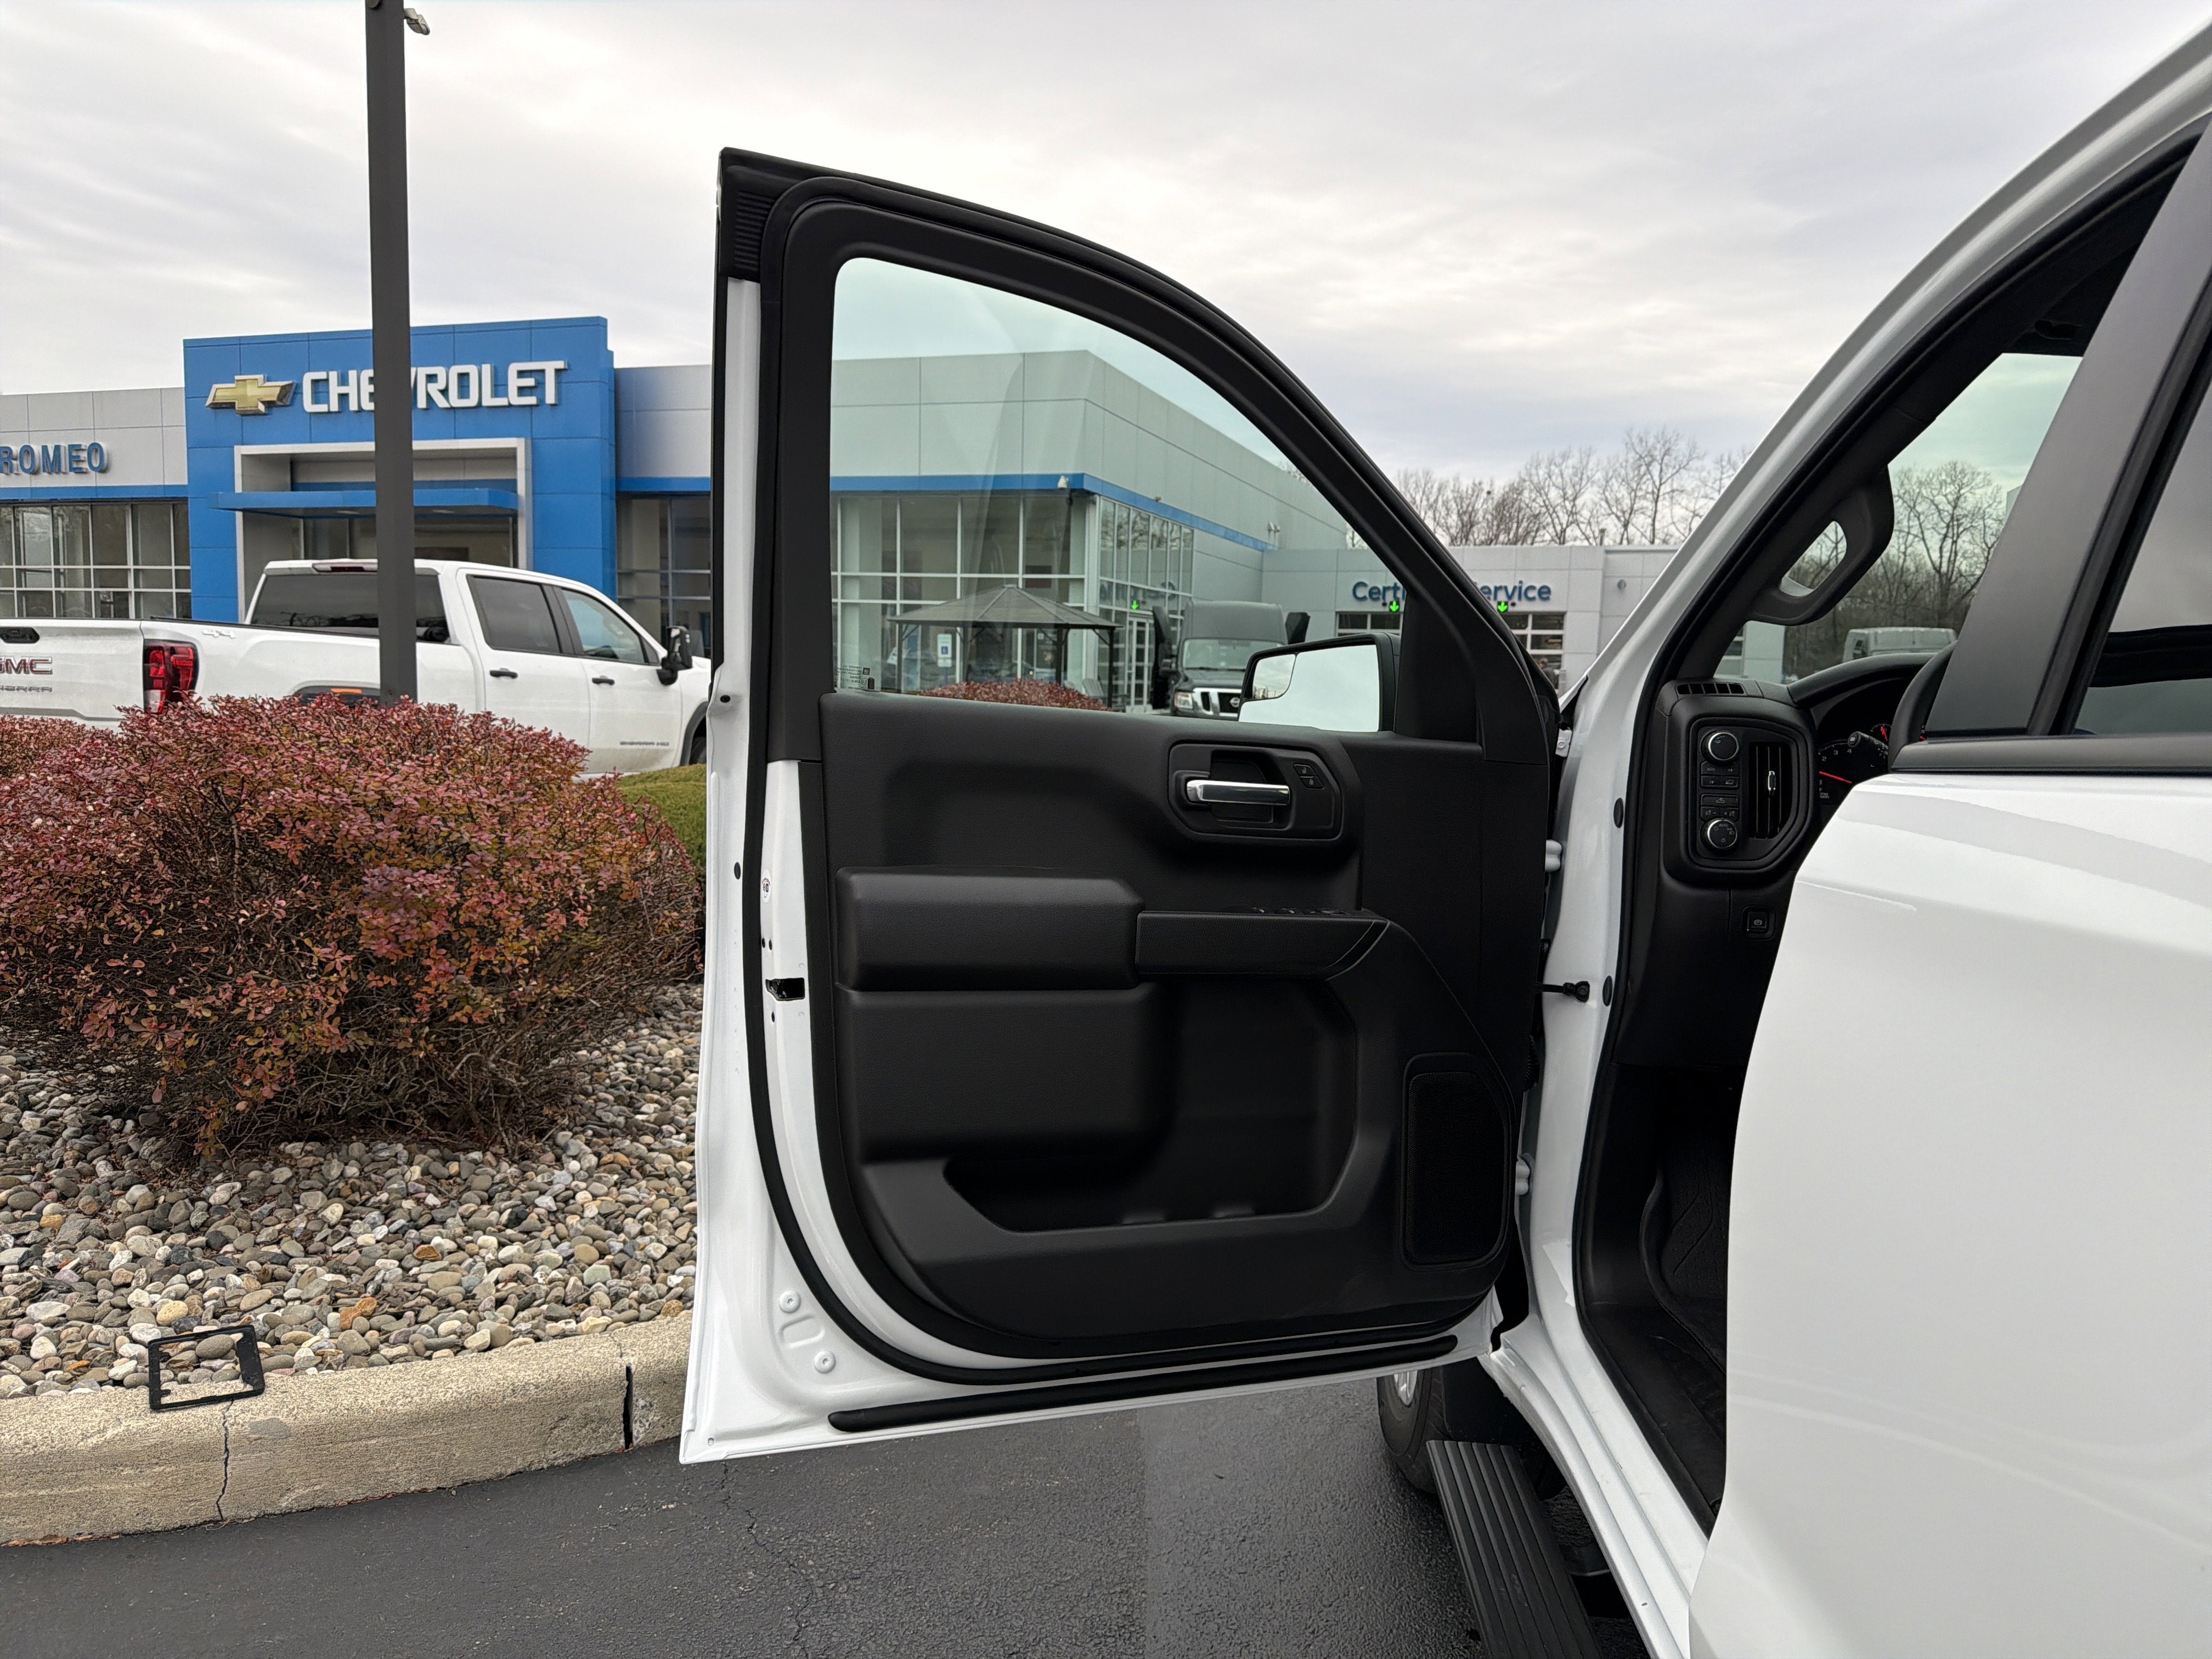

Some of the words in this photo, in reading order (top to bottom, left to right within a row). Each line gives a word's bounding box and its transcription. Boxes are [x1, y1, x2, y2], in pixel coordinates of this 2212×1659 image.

[303, 360, 566, 413] CHEROLET
[0, 442, 108, 475] ROMEO
[1475, 580, 1551, 601] ervice
[0, 656, 53, 674] MC
